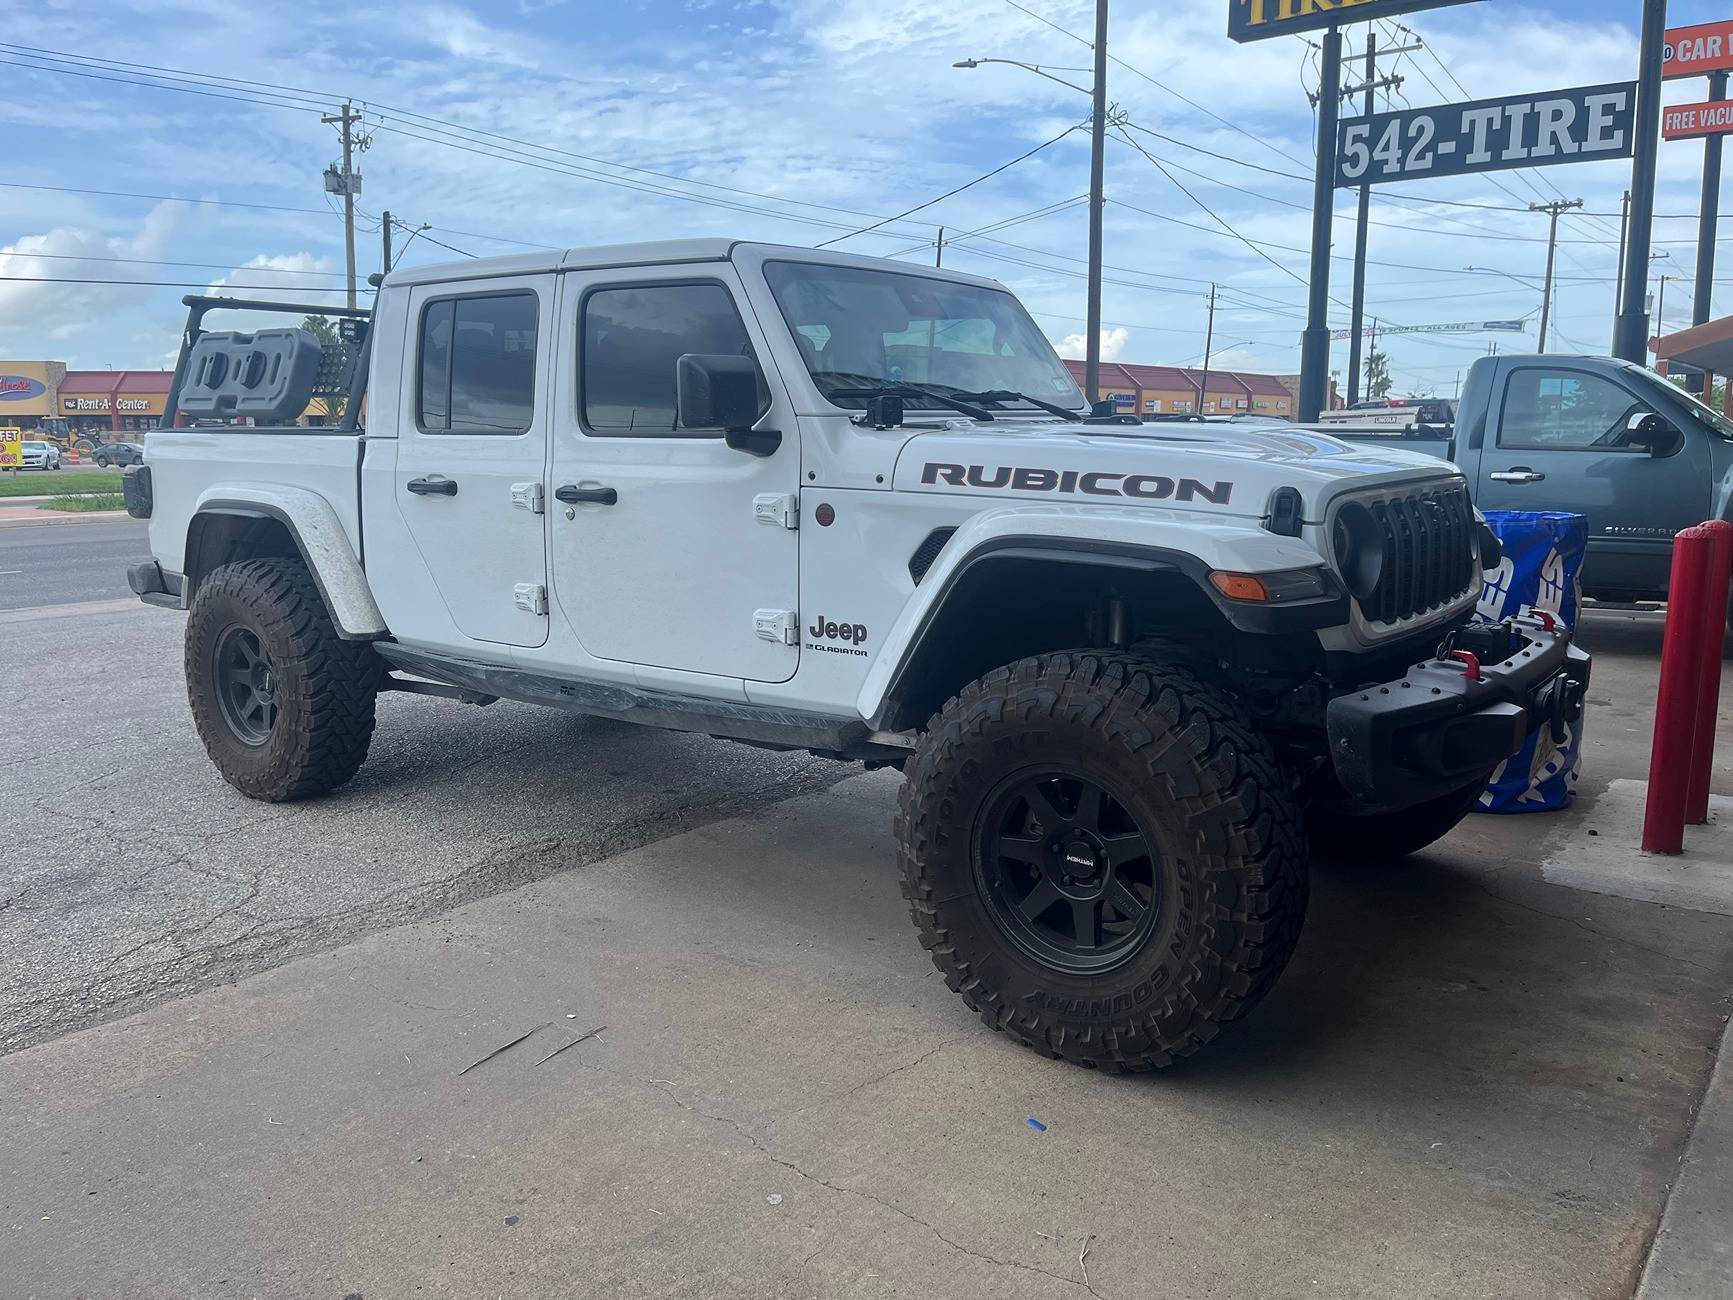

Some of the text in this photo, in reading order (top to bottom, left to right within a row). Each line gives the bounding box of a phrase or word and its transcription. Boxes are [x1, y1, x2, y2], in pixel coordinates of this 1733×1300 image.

[1677, 35, 1722, 62] CAR
[1341, 92, 1627, 178] 542-TIRE
[1665, 111, 1696, 130] FREE
[920, 462, 1234, 505] RUBICON
[1605, 526, 1679, 535] SILVERAD
[809, 615, 868, 646] Jeep
[814, 644, 869, 657] GLADIATOR
[1167, 858, 1194, 961] OPEN
